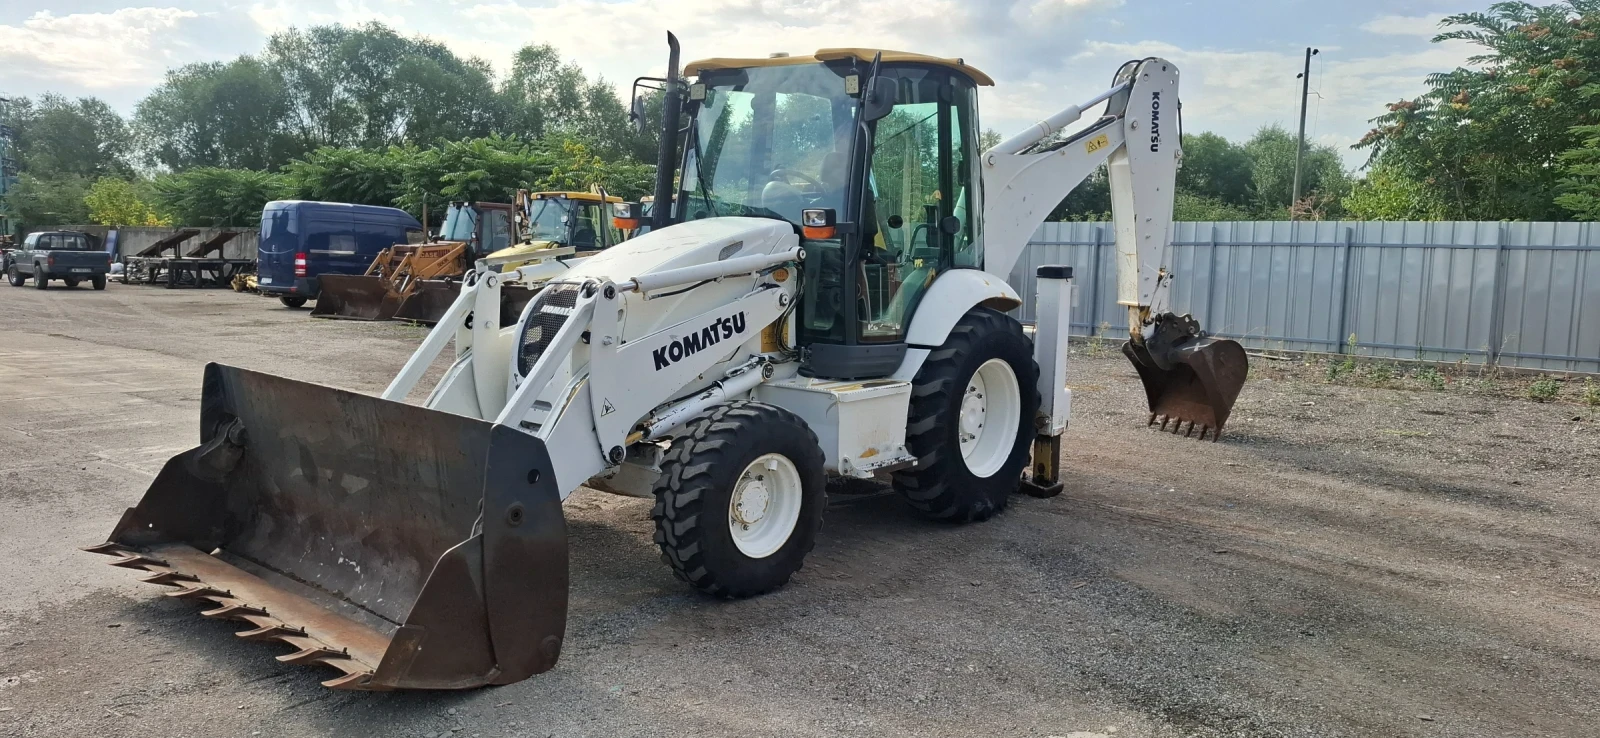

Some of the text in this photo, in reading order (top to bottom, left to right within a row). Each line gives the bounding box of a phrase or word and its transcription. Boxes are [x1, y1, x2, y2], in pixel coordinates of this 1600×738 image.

[1150, 91, 1160, 152] KOMATSU
[540, 304, 575, 316] KOMATS
[652, 311, 746, 371] KOMATSU
